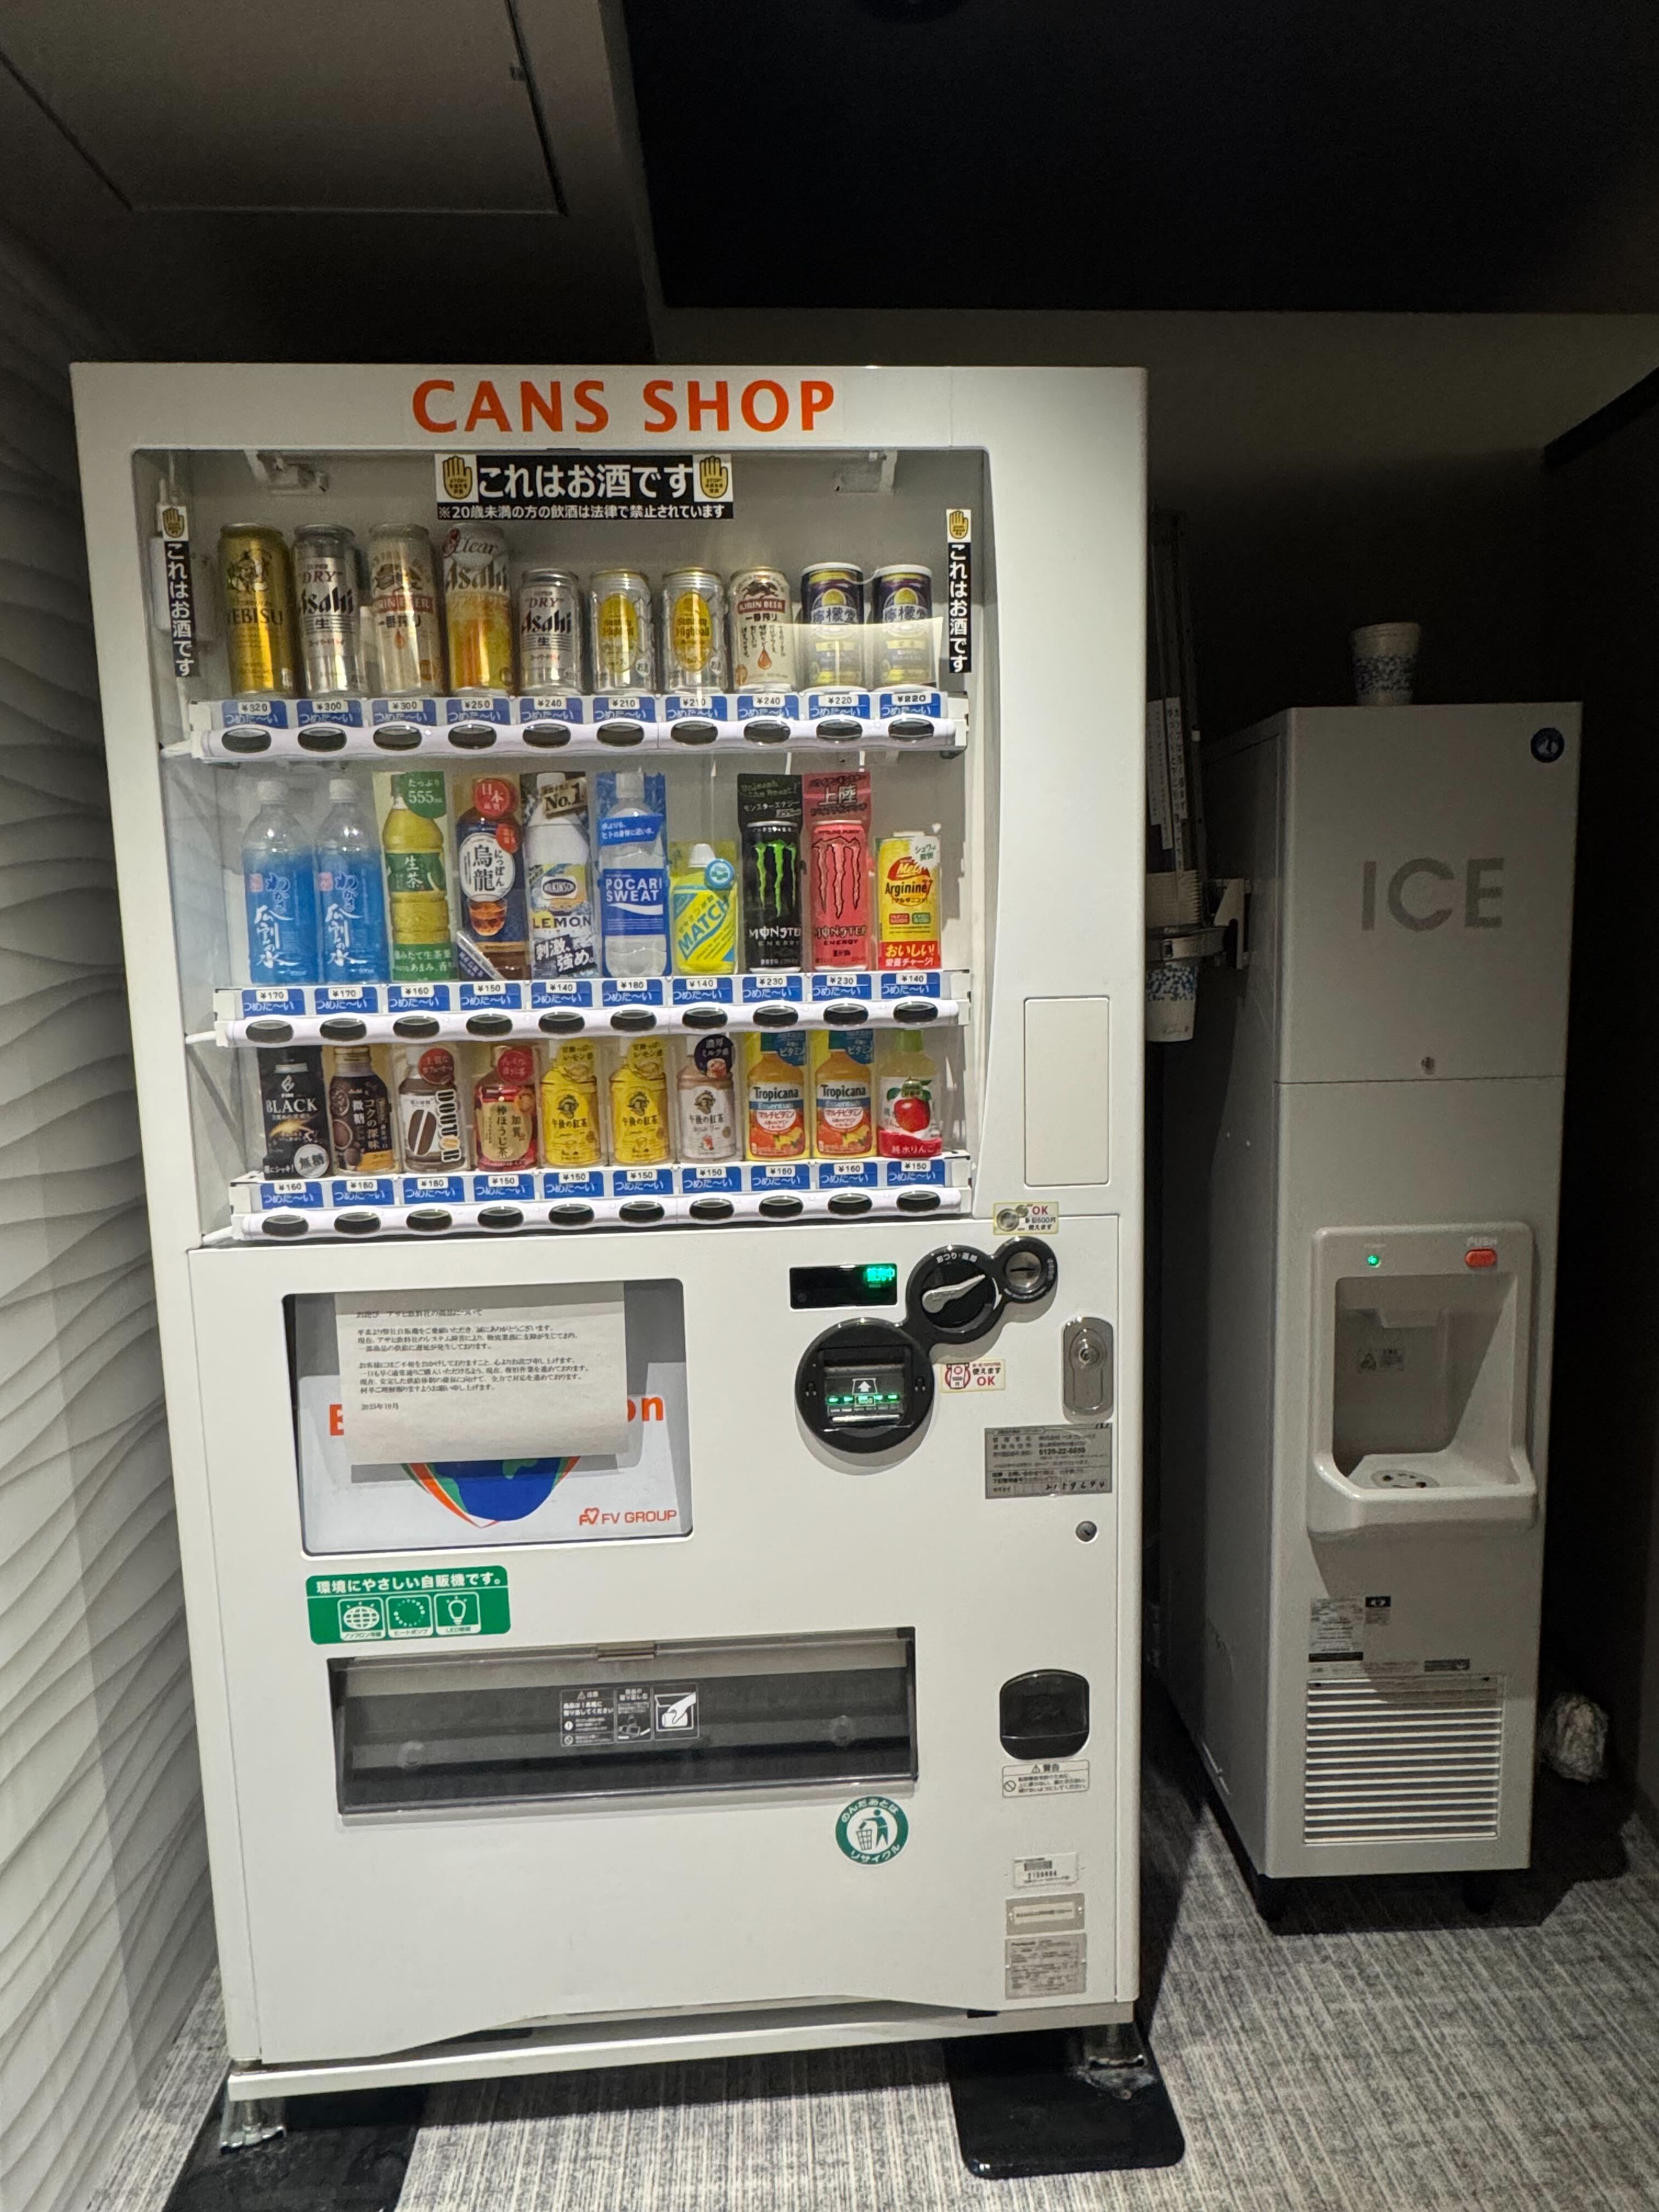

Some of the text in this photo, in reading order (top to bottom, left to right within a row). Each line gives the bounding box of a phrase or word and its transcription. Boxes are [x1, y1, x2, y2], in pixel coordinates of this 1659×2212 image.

[412, 380, 834, 433] CANS SHOP
[479, 464, 693, 498] これはお酒です
[446, 562, 506, 592] Asahi
[167, 543, 192, 676] これはお酒です
[949, 544, 968, 672] これはお酒です
[315, 618, 329, 629] 生
[522, 610, 571, 634] Asahi
[537, 636, 550, 646] 生
[408, 791, 435, 804] 555
[545, 782, 585, 811] No.1
[818, 786, 857, 805] 上陸
[404, 855, 423, 889] 生茶
[543, 882, 576, 893] WILKINSON
[606, 877, 662, 890] POCARI
[885, 881, 928, 897] Arginine
[606, 890, 659, 902] SWEAT
[1361, 857, 1505, 933] ICE
[533, 915, 591, 929] LEMON
[678, 895, 730, 952] MATCH
[749, 926, 801, 940] MONSTE
[752, 1086, 799, 1101] Tropicana
[821, 1084, 866, 1099] Tropicana
[266, 1098, 319, 1114] BLACK
[436, 1089, 462, 1162] DOUTOR
[1032, 1205, 1048, 1215] OK
[1466, 1236, 1498, 1247] PUSH
[977, 1375, 996, 1386] OK
[602, 1509, 678, 1525] FV GROUP
[316, 1571, 501, 1594] 環境にやさしい自販機です。
